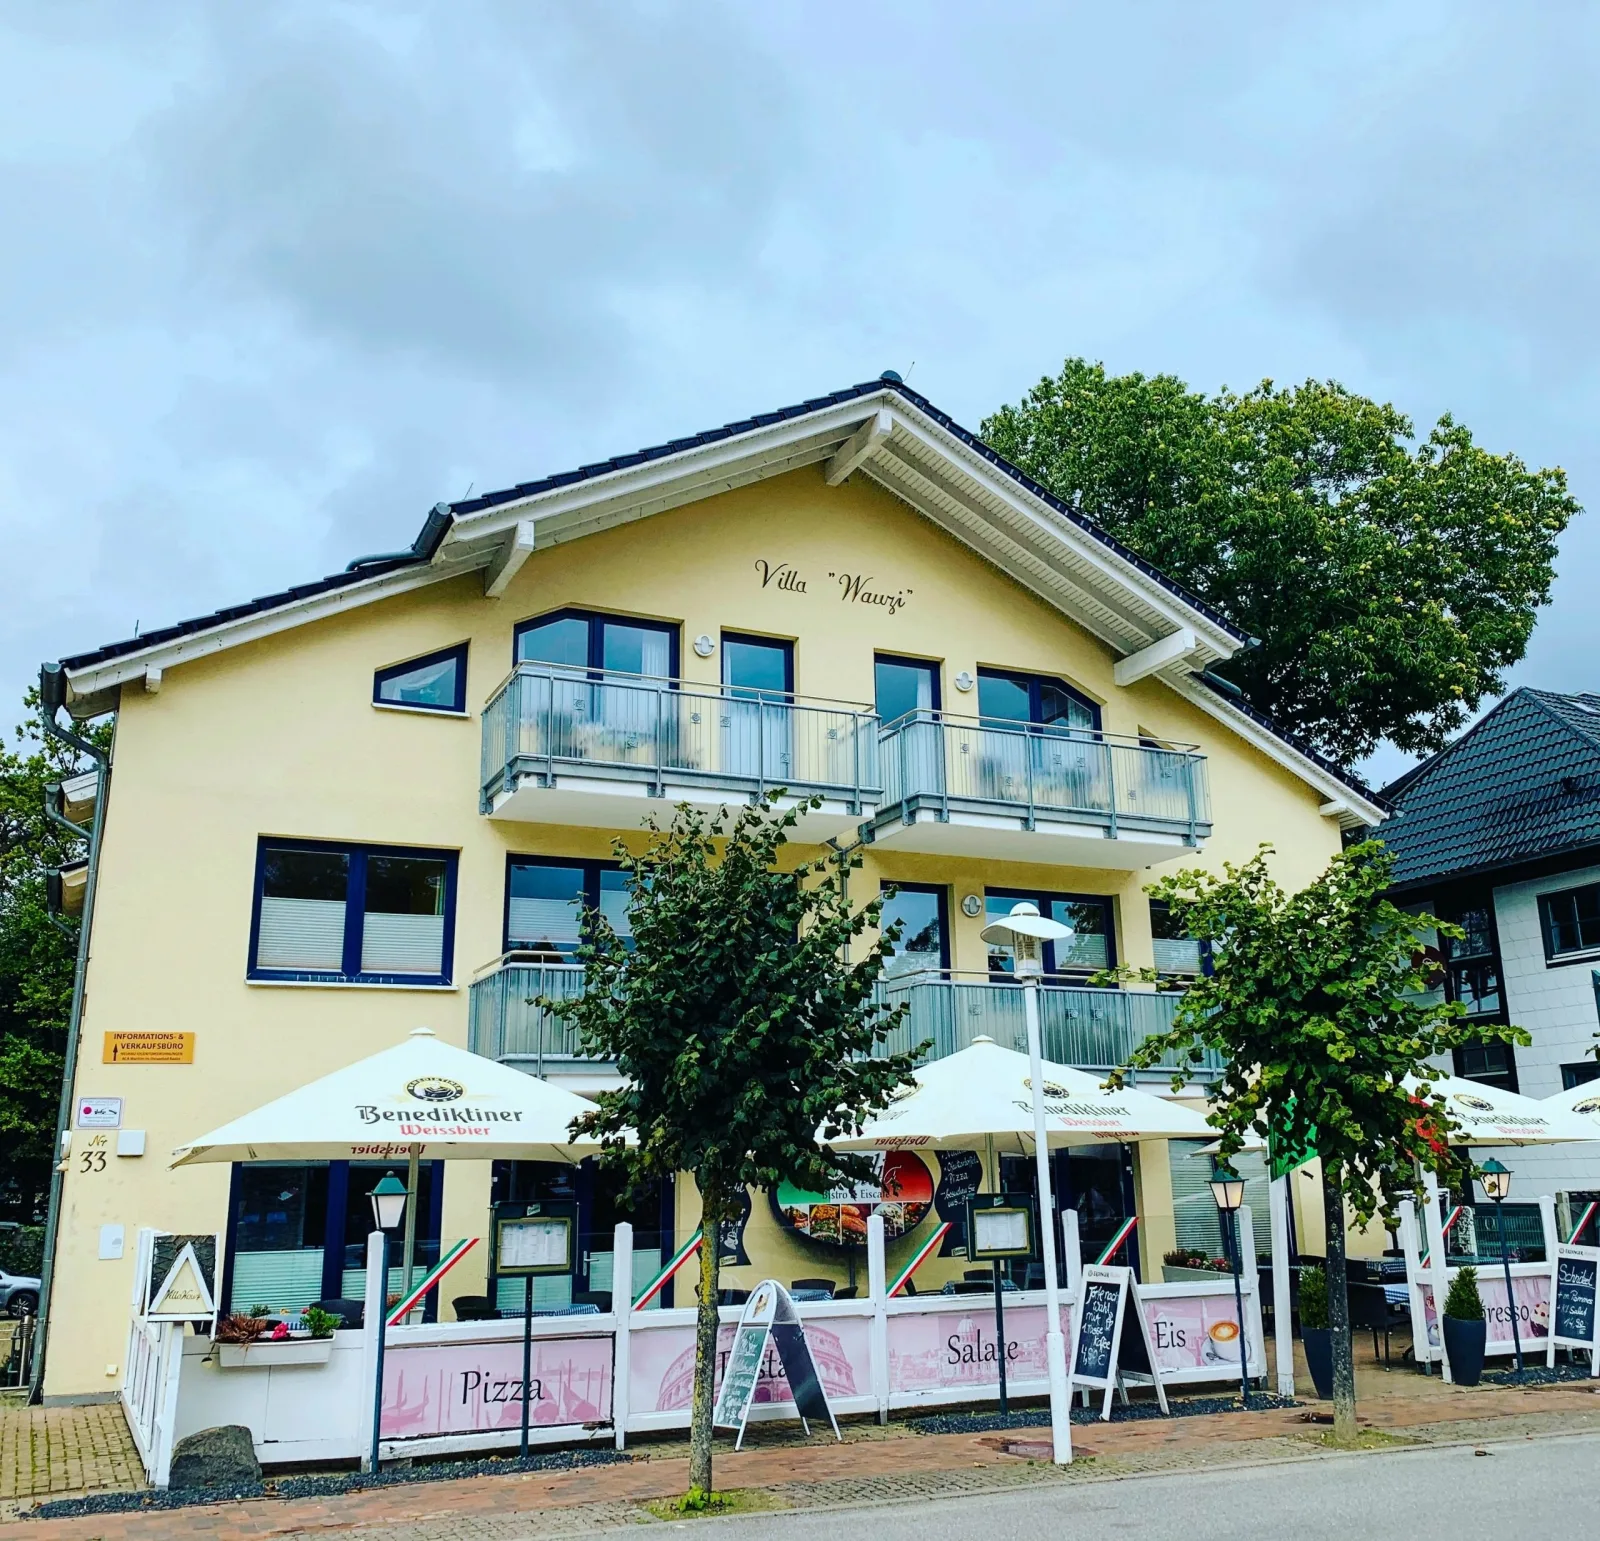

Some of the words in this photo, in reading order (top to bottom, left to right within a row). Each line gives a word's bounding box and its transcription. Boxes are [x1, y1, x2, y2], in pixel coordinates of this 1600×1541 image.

[755, 559, 807, 594] Villa
[121, 1042, 184, 1050] VERKAUFSBÜRO
[355, 1105, 523, 1125] Benediktiner
[1012, 1100, 1132, 1116] Bnediktiner
[400, 1124, 490, 1136] Weissbier
[80, 1150, 107, 1174] 33
[948, 1172, 969, 1184] Pizza
[823, 1189, 848, 1200] Bistro
[1085, 1285, 1104, 1304] Torte
[1092, 1301, 1110, 1314] Wahl
[1085, 1311, 1101, 1325] mit
[1153, 1321, 1186, 1349] Eis
[947, 1328, 1019, 1365] Salae
[1098, 1354, 1106, 1366] €
[460, 1370, 546, 1405] Pizza
